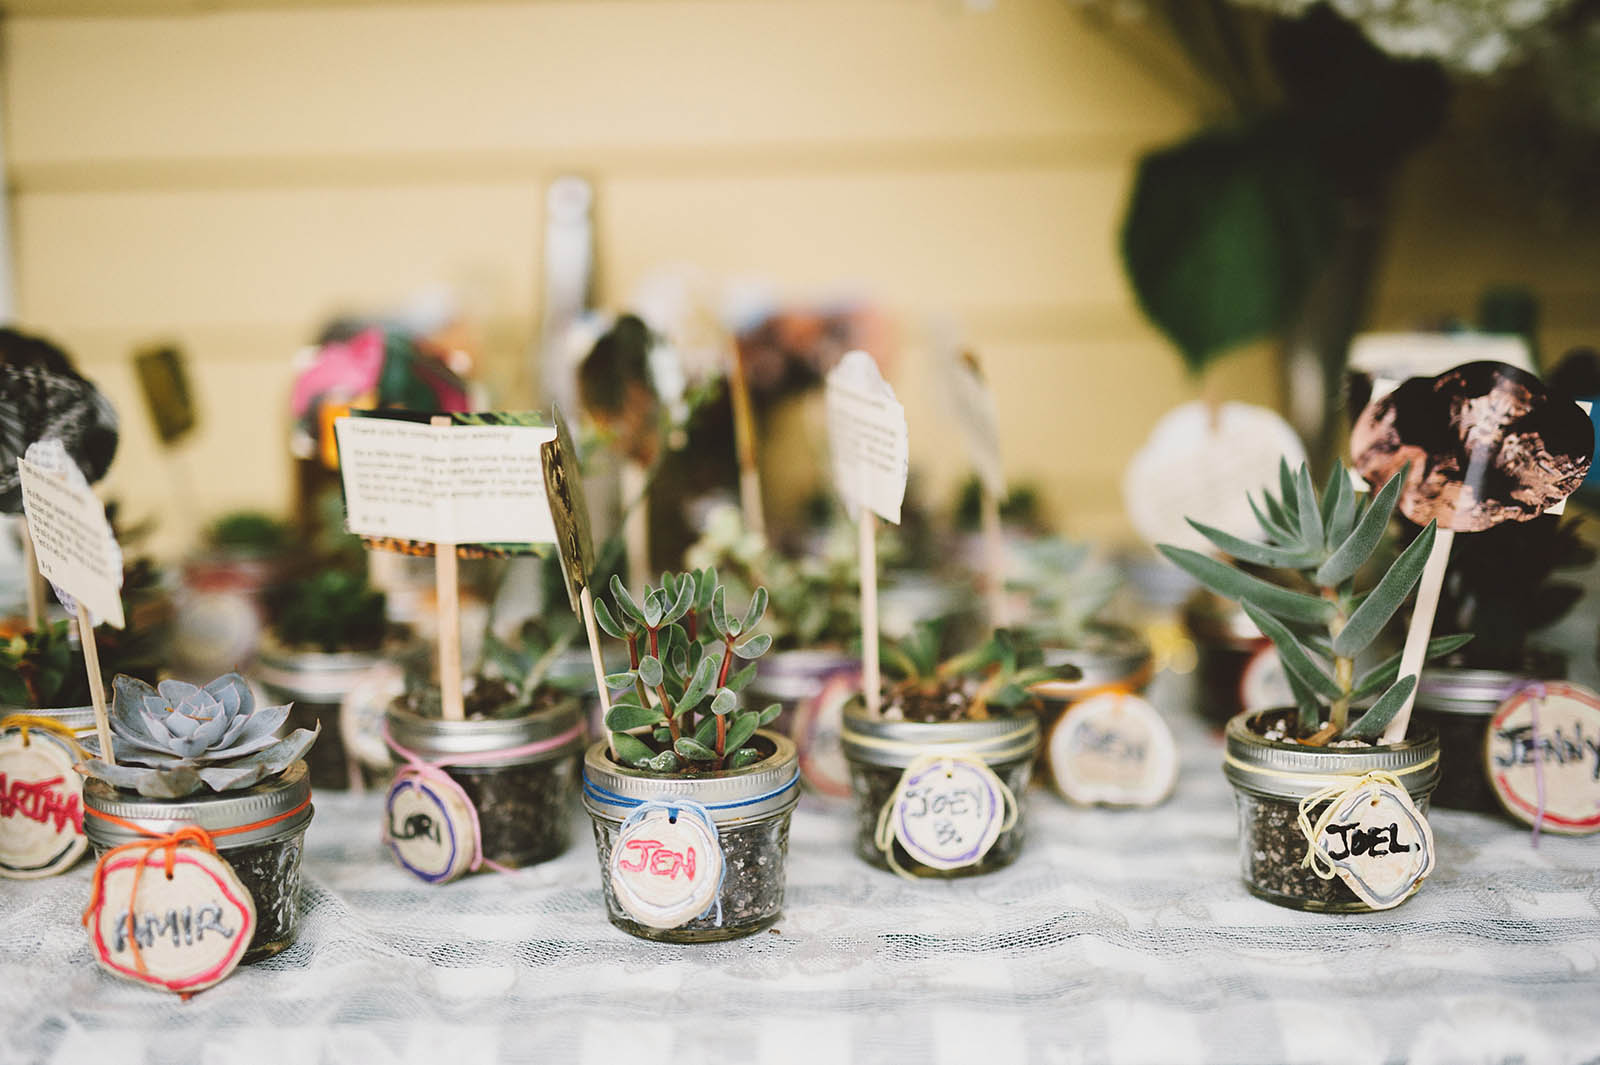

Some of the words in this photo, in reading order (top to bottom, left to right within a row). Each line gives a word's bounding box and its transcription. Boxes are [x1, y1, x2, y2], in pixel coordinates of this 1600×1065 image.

[905, 785, 983, 820] JOEY
[389, 812, 442, 845] LORI
[619, 840, 697, 882] JEN
[113, 903, 235, 953] AMIR
